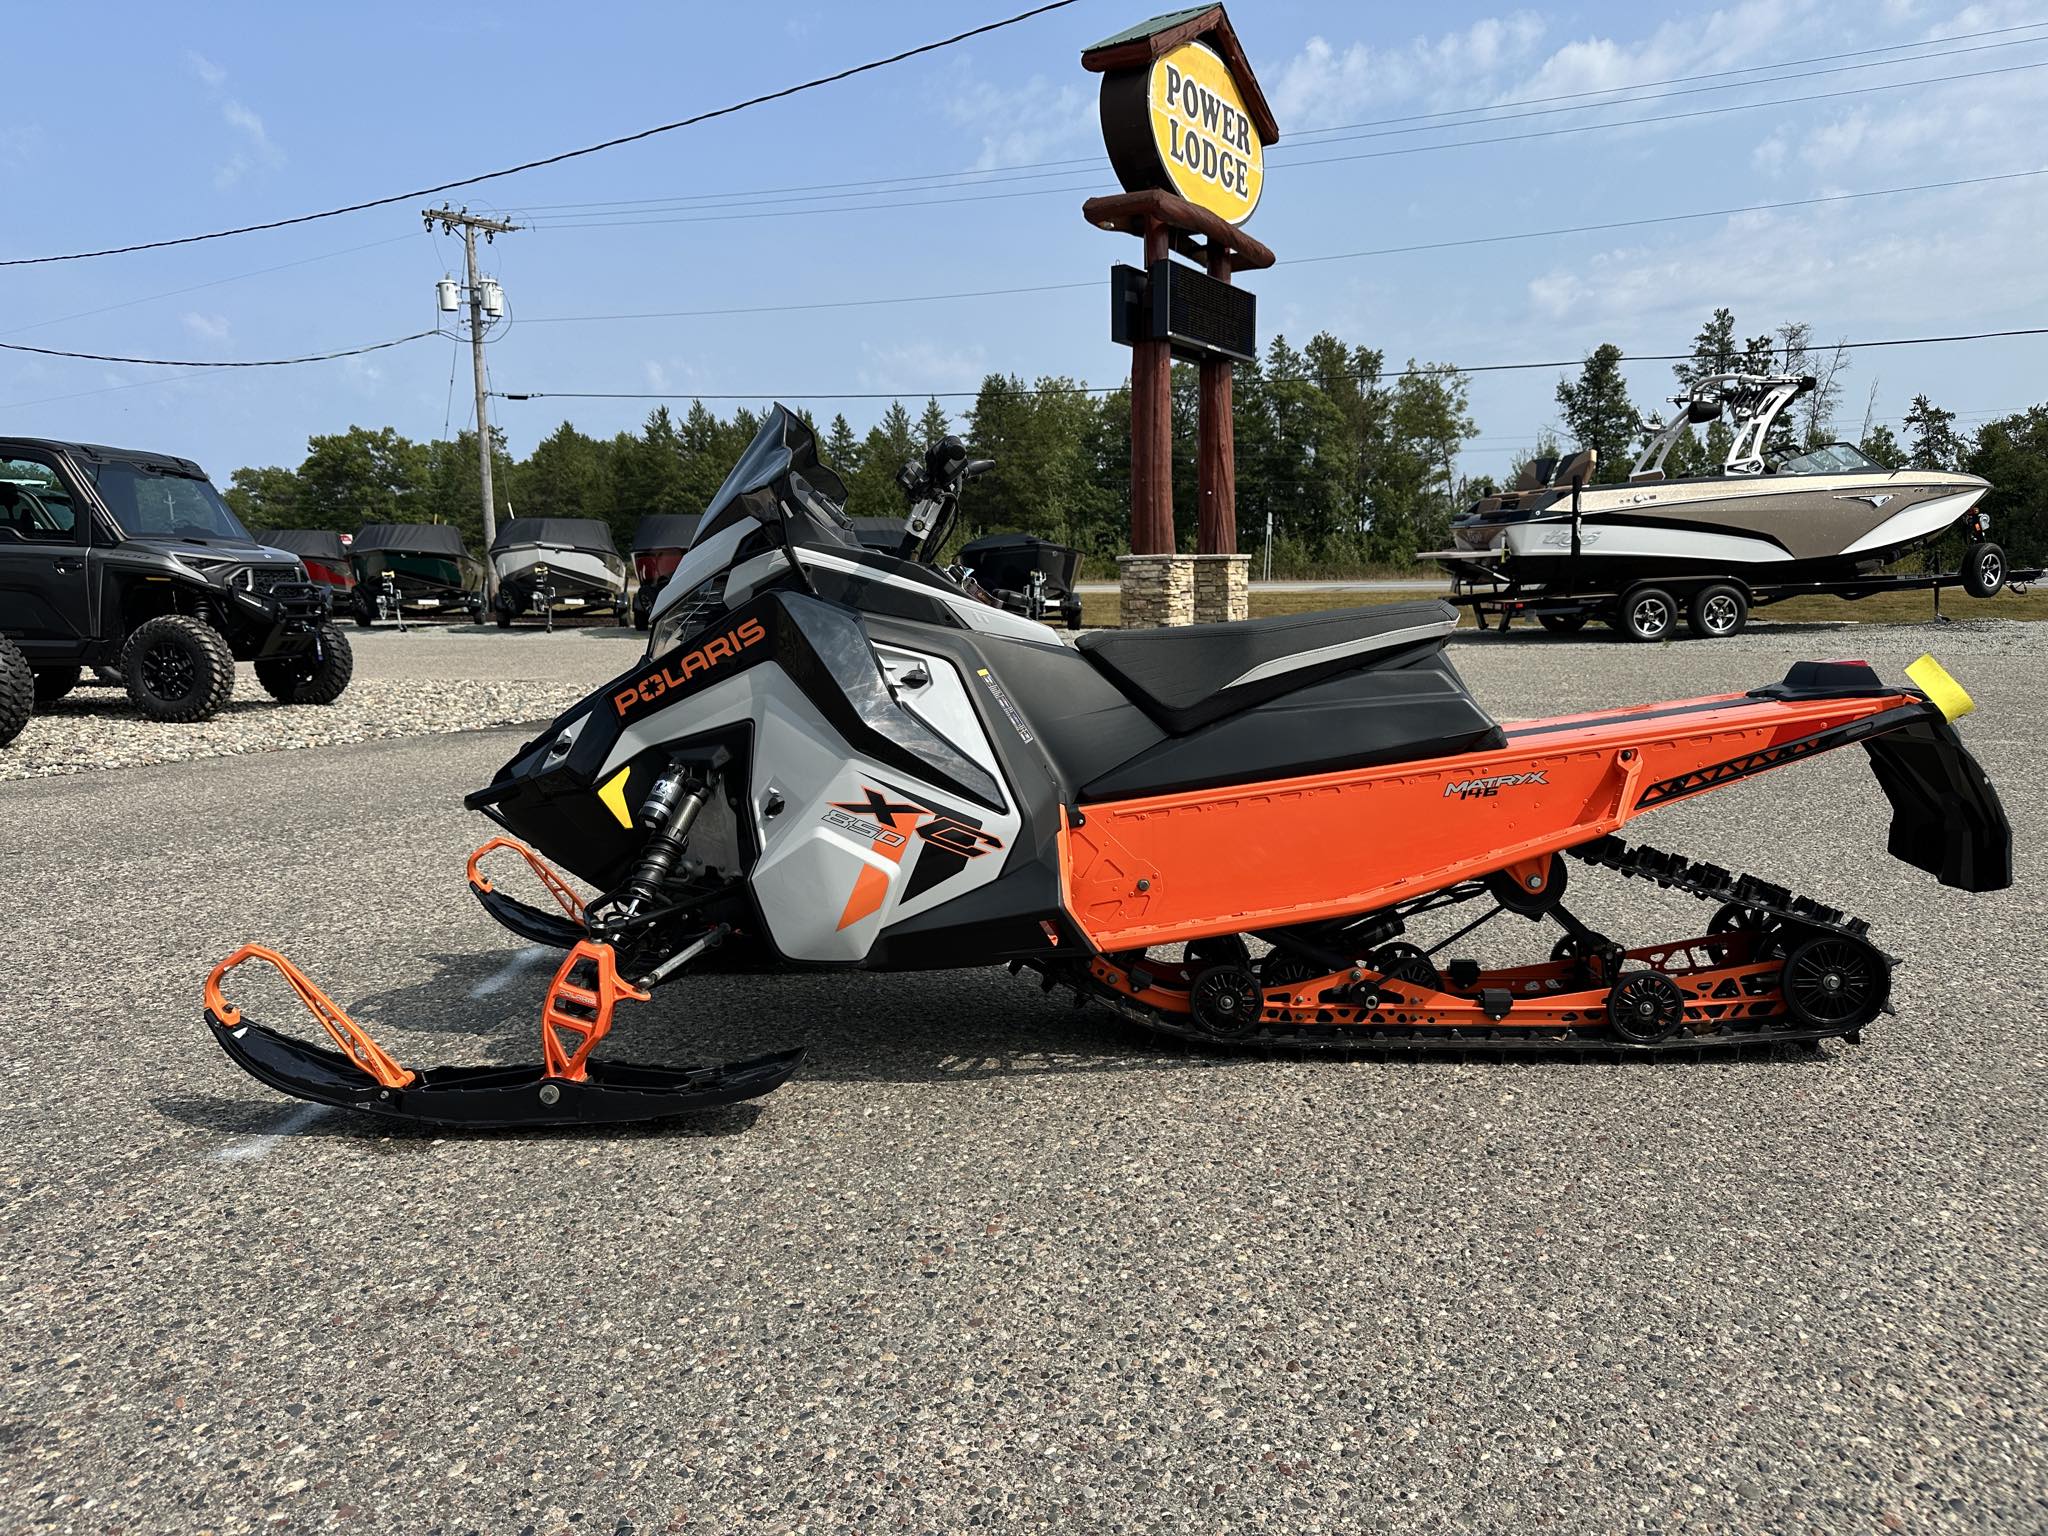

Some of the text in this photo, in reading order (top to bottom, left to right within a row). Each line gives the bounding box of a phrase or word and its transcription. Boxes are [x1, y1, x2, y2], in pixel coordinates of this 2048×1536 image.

[1166, 64, 1251, 156] POWER
[1169, 118, 1249, 199] LODGE
[614, 617, 766, 716] POLARIS
[1443, 770, 1550, 797] MATRYX
[1460, 787, 1498, 800] 146
[821, 809, 907, 848] 850
